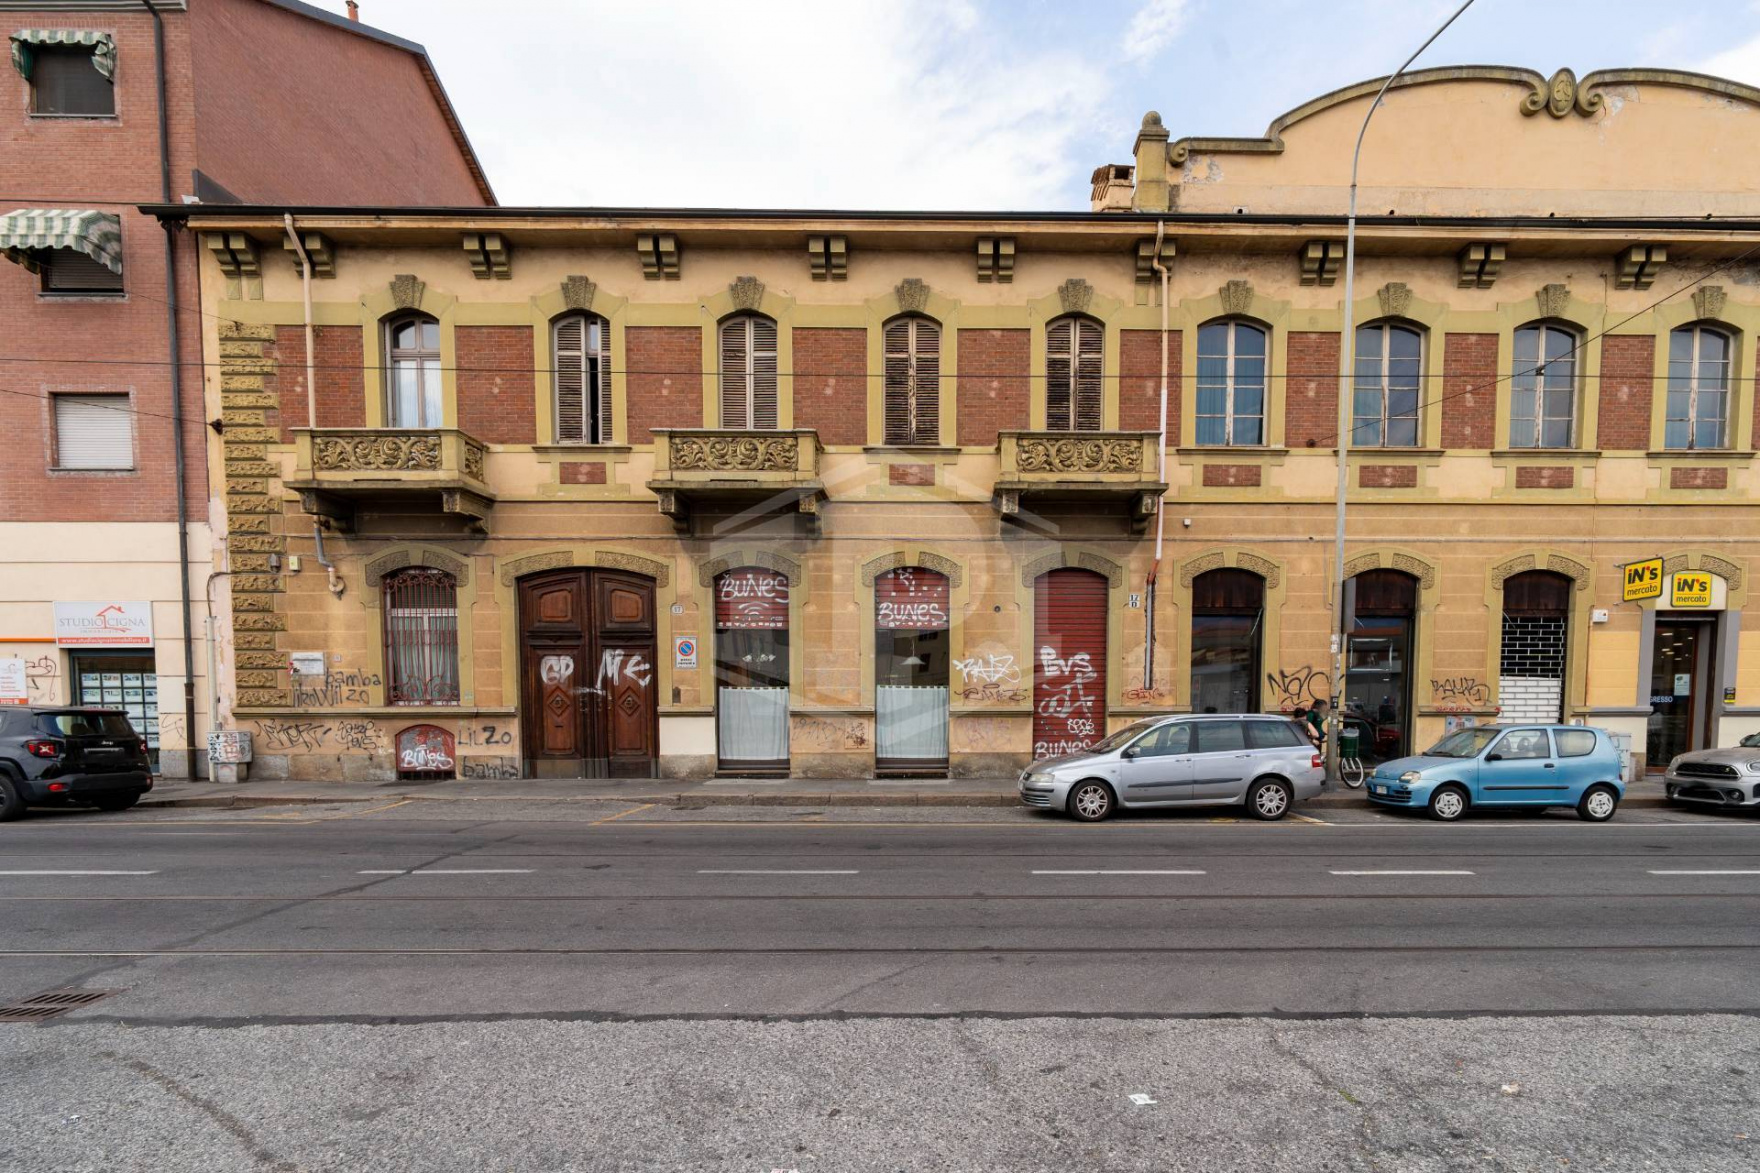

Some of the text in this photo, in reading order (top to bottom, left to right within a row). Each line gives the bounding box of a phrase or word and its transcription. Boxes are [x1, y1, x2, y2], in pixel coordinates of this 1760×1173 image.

[1626, 584, 1658, 597] mercato
[1675, 595, 1707, 604] mercato
[59, 617, 146, 627] STUDIO CIGNA
